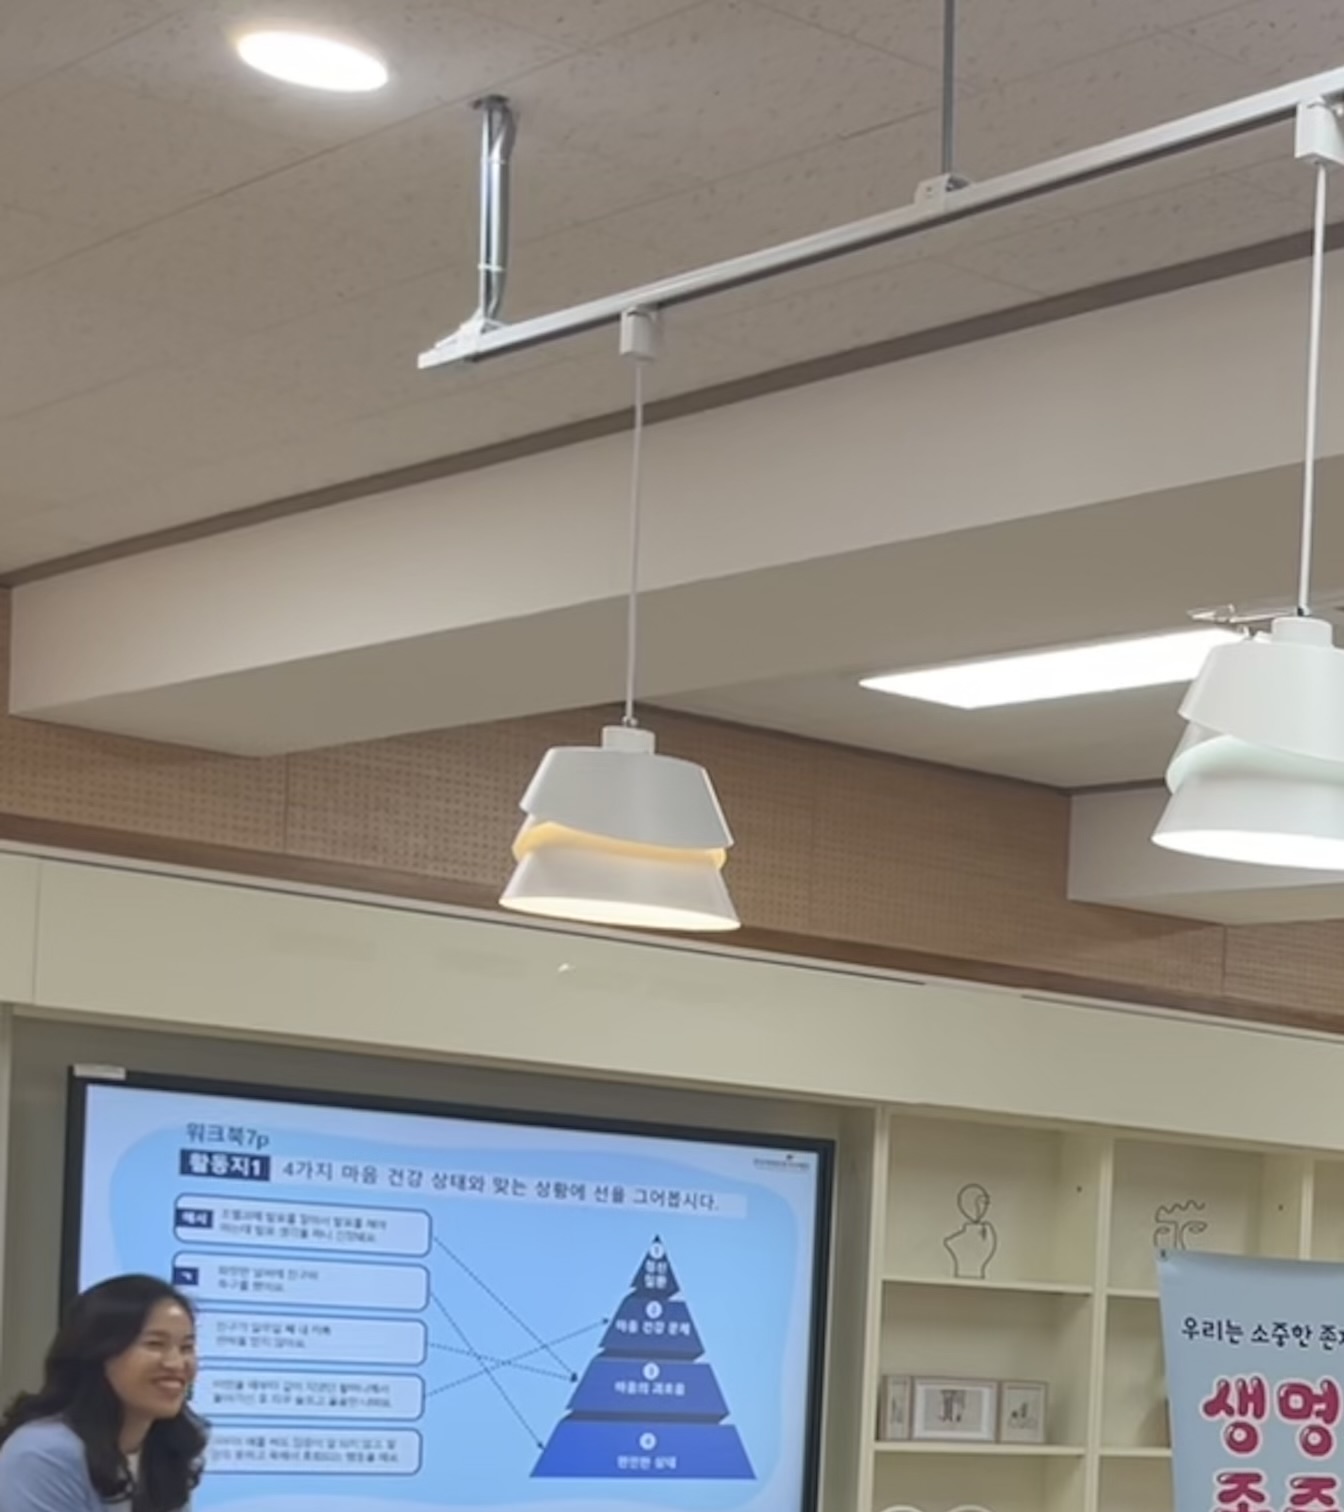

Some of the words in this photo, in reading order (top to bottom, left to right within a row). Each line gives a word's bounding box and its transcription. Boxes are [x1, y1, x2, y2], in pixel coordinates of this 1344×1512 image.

[186, 1122, 270, 1150] 워크북7p
[189, 1152, 262, 1178] 활동지1
[282, 1160, 333, 1181] 4가지
[341, 1163, 378, 1185] 마음
[388, 1167, 424, 1188] 건강
[431, 1172, 485, 1193] 상태와
[492, 1176, 528, 1197] 맞는
[535, 1180, 586, 1201] 상황에
[594, 1184, 625, 1204] 선을
[1181, 1316, 1244, 1345] 우리는
[1250, 1321, 1313, 1348] 소중한
[1202, 1375, 1341, 1457] 생명
